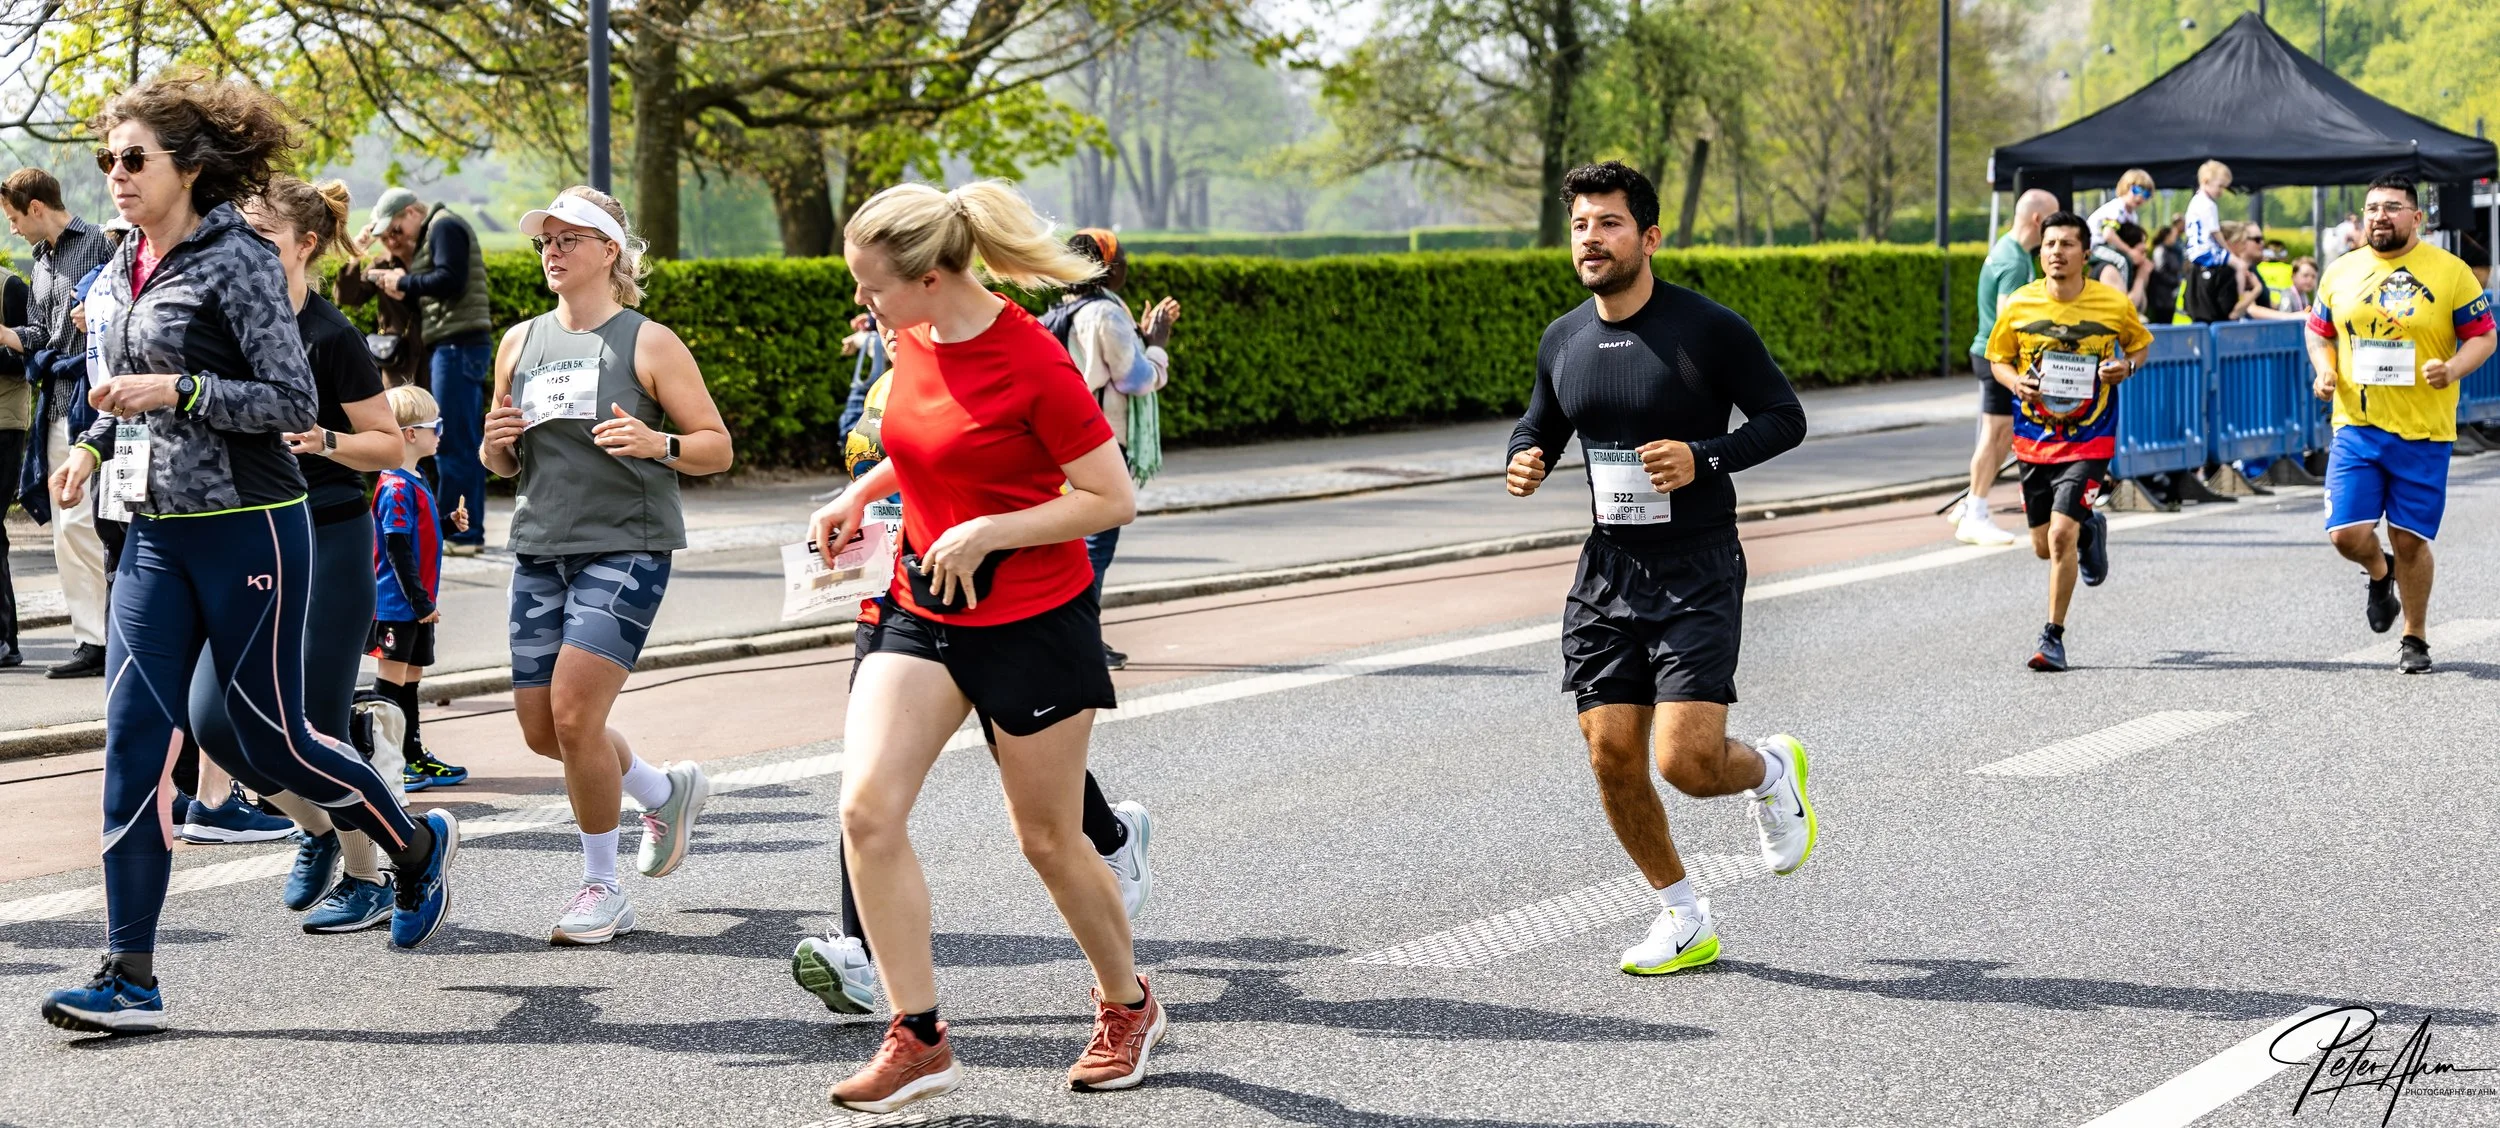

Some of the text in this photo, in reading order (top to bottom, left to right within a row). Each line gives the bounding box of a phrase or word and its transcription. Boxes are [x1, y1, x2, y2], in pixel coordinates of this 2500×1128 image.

[1598, 341, 1625, 349] CRAFT
[573, 360, 584, 368] 5K
[2052, 364, 2085, 373] MATHIAS
[547, 392, 565, 403] 166
[1593, 451, 1637, 463] STRANDVEJEN
[1613, 492, 1635, 503] 522
